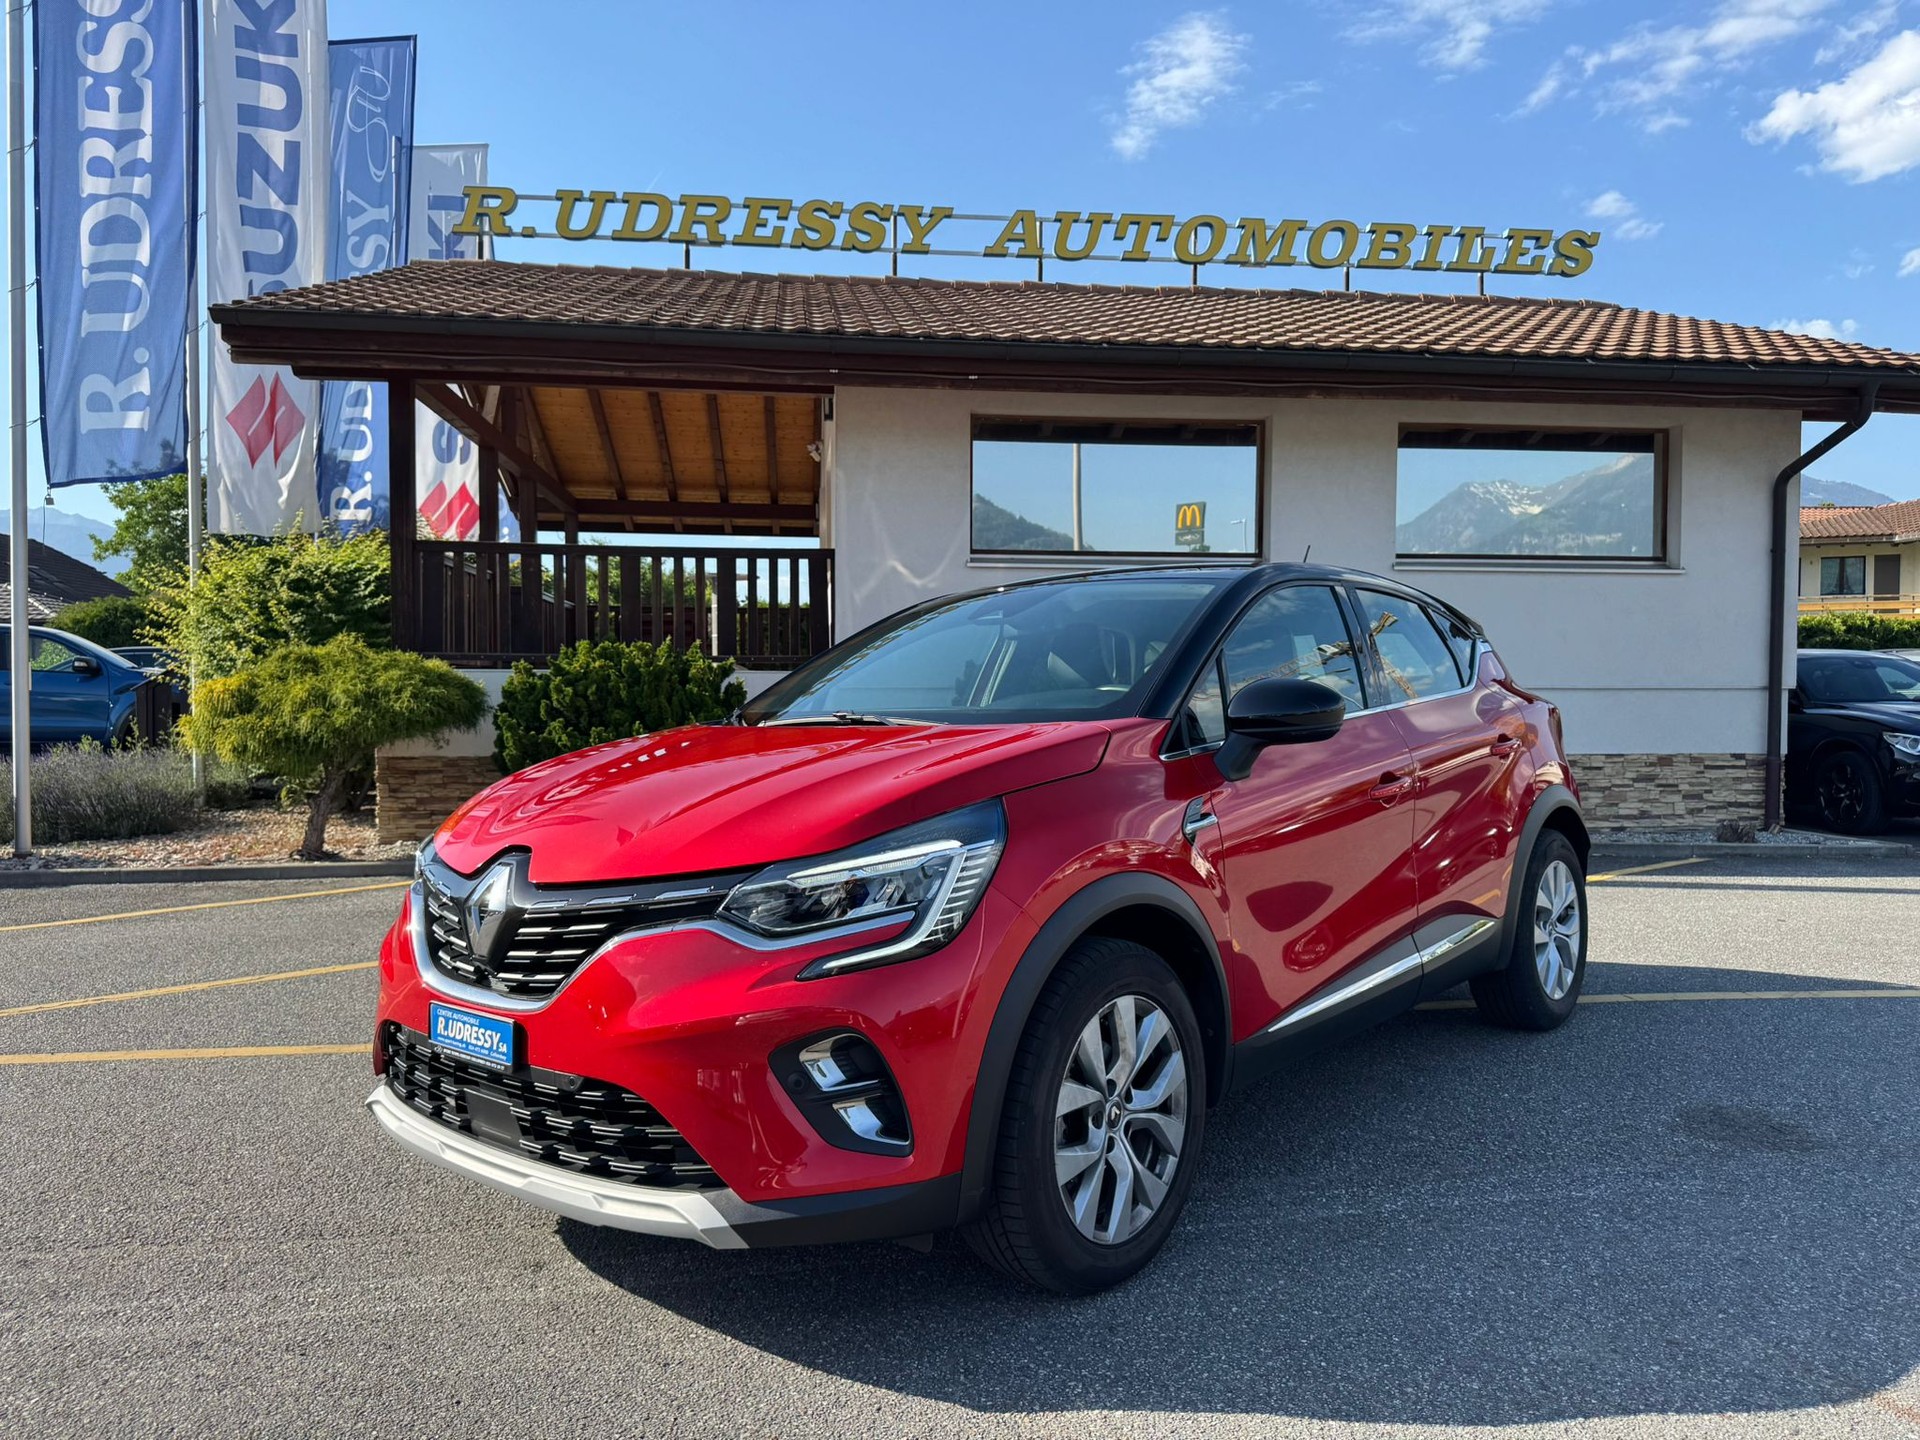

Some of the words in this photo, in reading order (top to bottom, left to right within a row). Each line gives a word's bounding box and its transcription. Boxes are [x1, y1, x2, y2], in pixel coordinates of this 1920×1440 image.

[233, 0, 303, 296] UZUK
[983, 209, 1600, 277] AUTOMOBILES
[498, 1042, 508, 1054] SA
